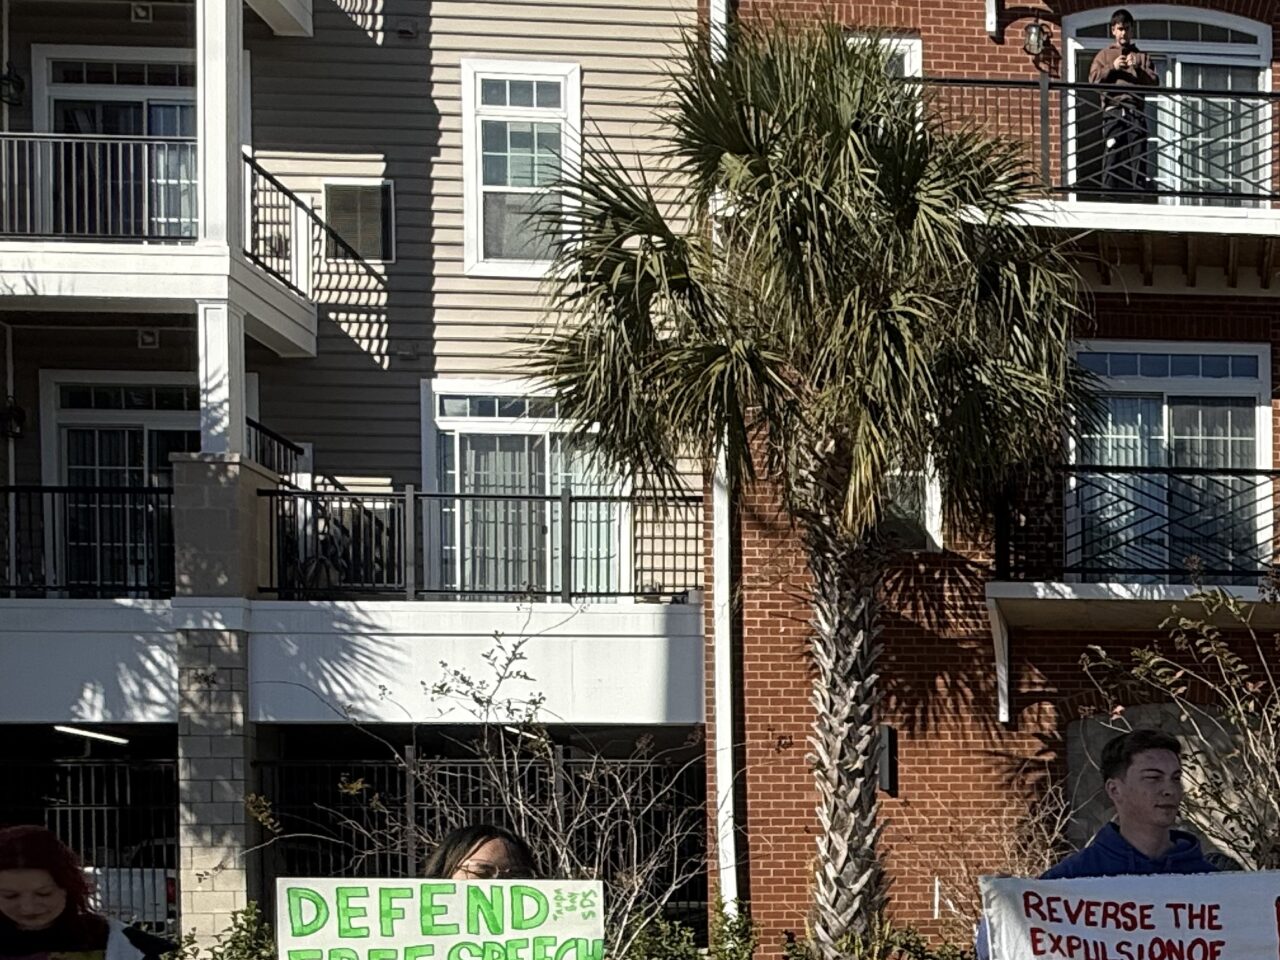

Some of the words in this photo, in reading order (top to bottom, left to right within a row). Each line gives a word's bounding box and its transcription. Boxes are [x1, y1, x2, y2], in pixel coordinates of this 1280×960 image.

[286, 883, 550, 938] DEFEND
[580, 888, 598, 921] SDS
[1022, 890, 1156, 931] REVERSE
[1165, 903, 1224, 931] THE
